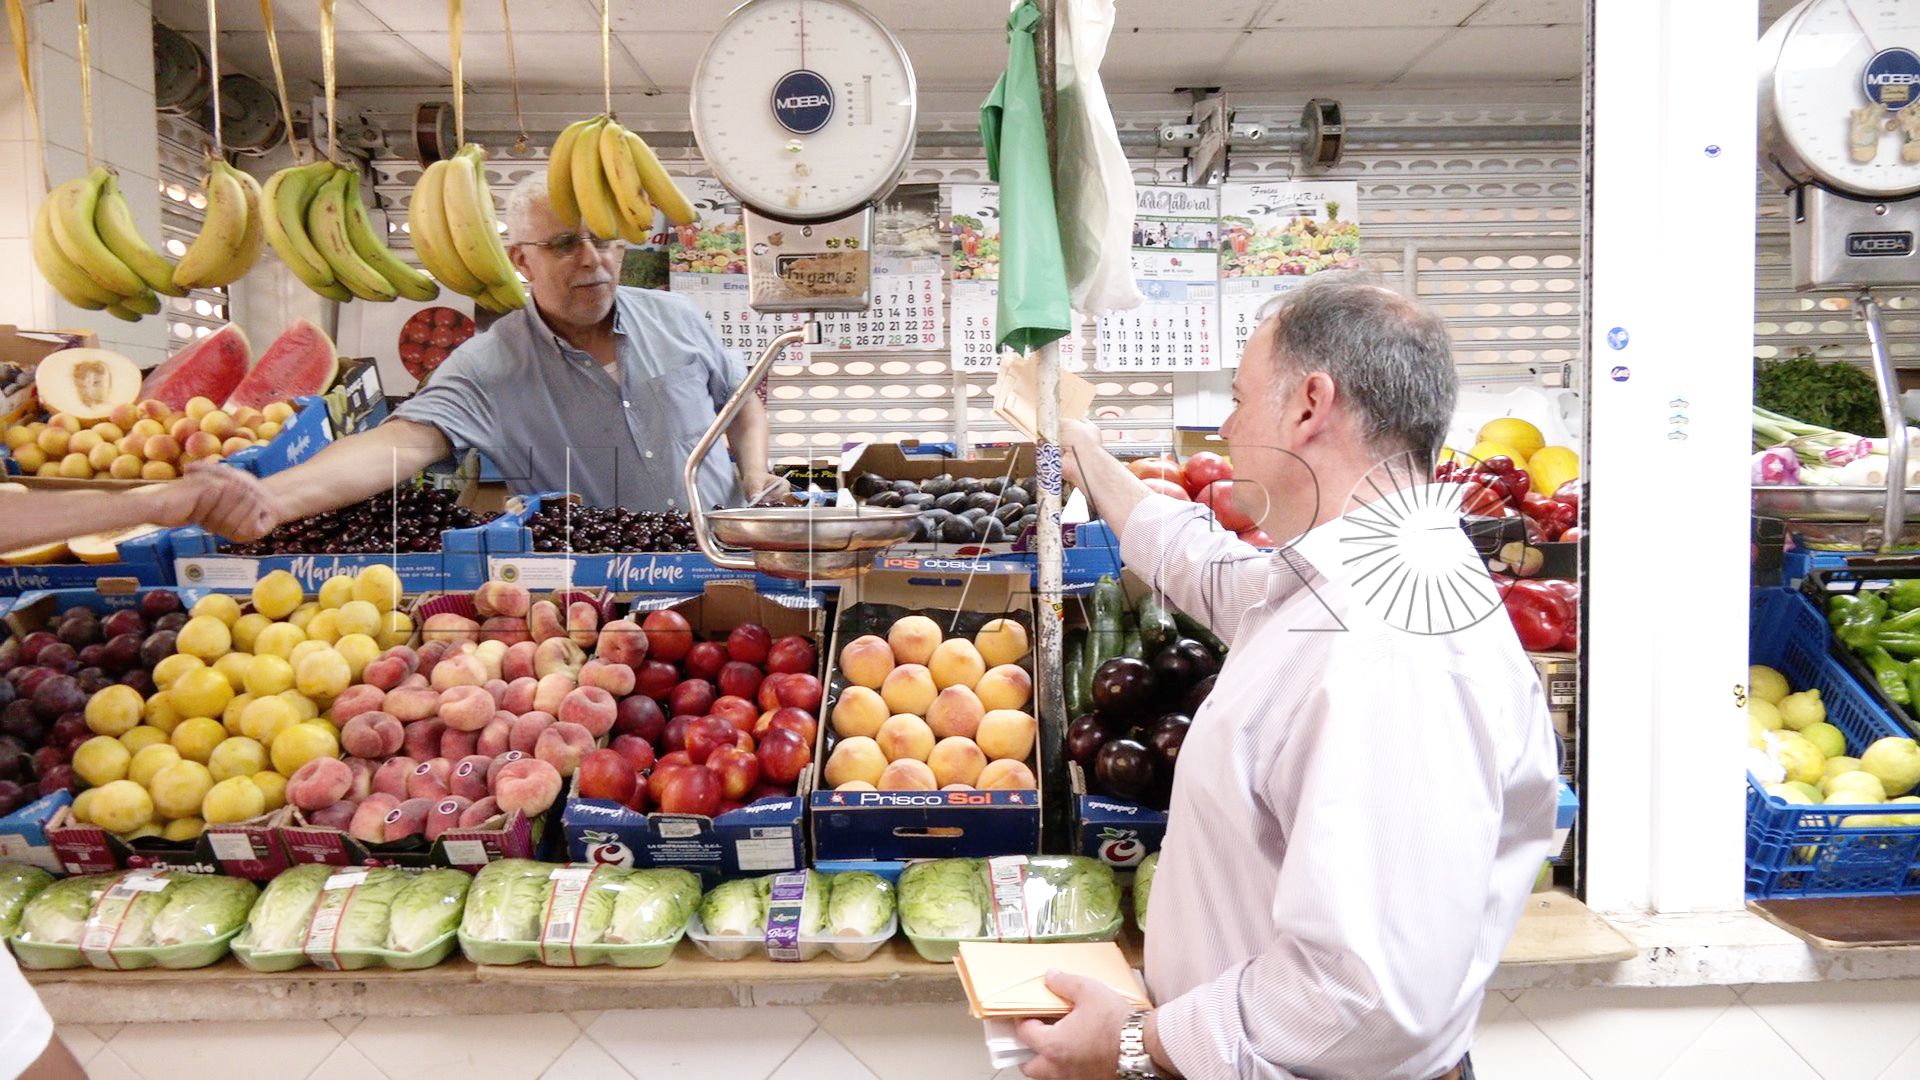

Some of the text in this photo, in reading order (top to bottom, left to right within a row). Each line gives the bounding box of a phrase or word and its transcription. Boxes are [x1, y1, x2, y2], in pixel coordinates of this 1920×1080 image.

[1869, 73, 1920, 85] MOBBA
[777, 95, 829, 110] MOBBA
[908, 280, 931, 290] 1 2
[874, 293, 932, 305] 6 7 8 9
[705, 311, 712, 320] 4
[723, 311, 730, 321] 5
[741, 312, 748, 321] 6
[873, 308, 883, 318] 13
[888, 308, 900, 318] 14
[906, 307, 917, 317] 15
[923, 307, 934, 317] 16
[967, 317, 989, 326] 5 6
[1104, 317, 1206, 328] 3 4 5 6 7 8 9
[1238, 313, 1245, 323] 3
[721, 325, 733, 335] 12
[740, 325, 750, 334] 13
[756, 325, 768, 334] 14
[825, 320, 935, 333] 17 18 19 20 21 22 23
[1235, 326, 1248, 336] 10
[964, 330, 990, 339] 12 13
[1102, 330, 1209, 340] 10 11 12 13 14 15 16
[722, 338, 768, 347] 19 20 21
[840, 336, 852, 346] 25
[856, 336, 869, 346] 26
[872, 335, 885, 345] 27
[889, 335, 902, 344] 28
[905, 334, 918, 344] 29
[922, 334, 936, 344] 30
[1236, 339, 1247, 349] 17
[964, 344, 1073, 353] 19 20 25
[1102, 343, 1209, 353] 17 18 19 20 21 22 23
[790, 351, 804, 361] 30
[1118, 356, 1209, 366] 25 26 27 28 29 30
[964, 357, 993, 366] 26 27
[884, 559, 991, 572] Prisco Sol
[607, 556, 684, 591] Marlene
[860, 792, 993, 806] Prisco Sol
[767, 927, 797, 939] Baby
